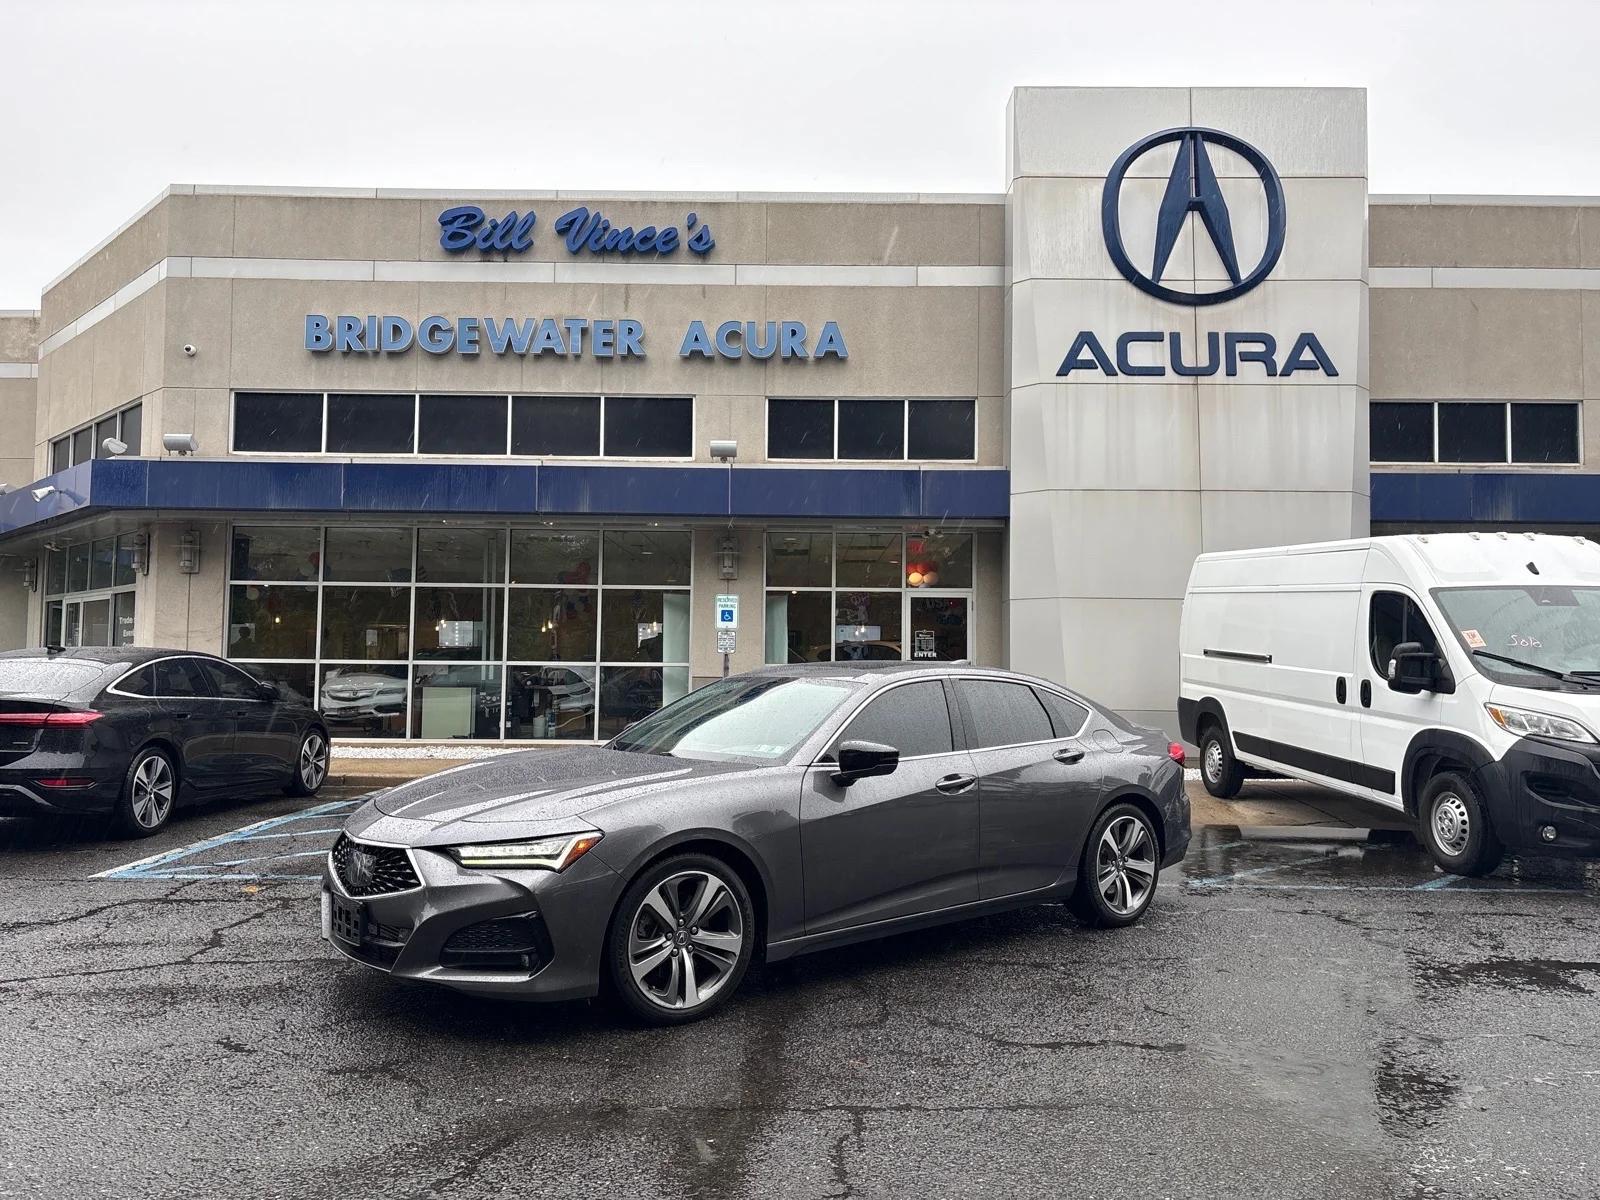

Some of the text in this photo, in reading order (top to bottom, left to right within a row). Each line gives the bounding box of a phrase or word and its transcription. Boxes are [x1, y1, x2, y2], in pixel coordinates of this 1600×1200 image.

[438, 205, 716, 255] Bill Vince's
[304, 313, 849, 360] BRIDGEWATER ACURA
[1055, 331, 1339, 377] ACURA
